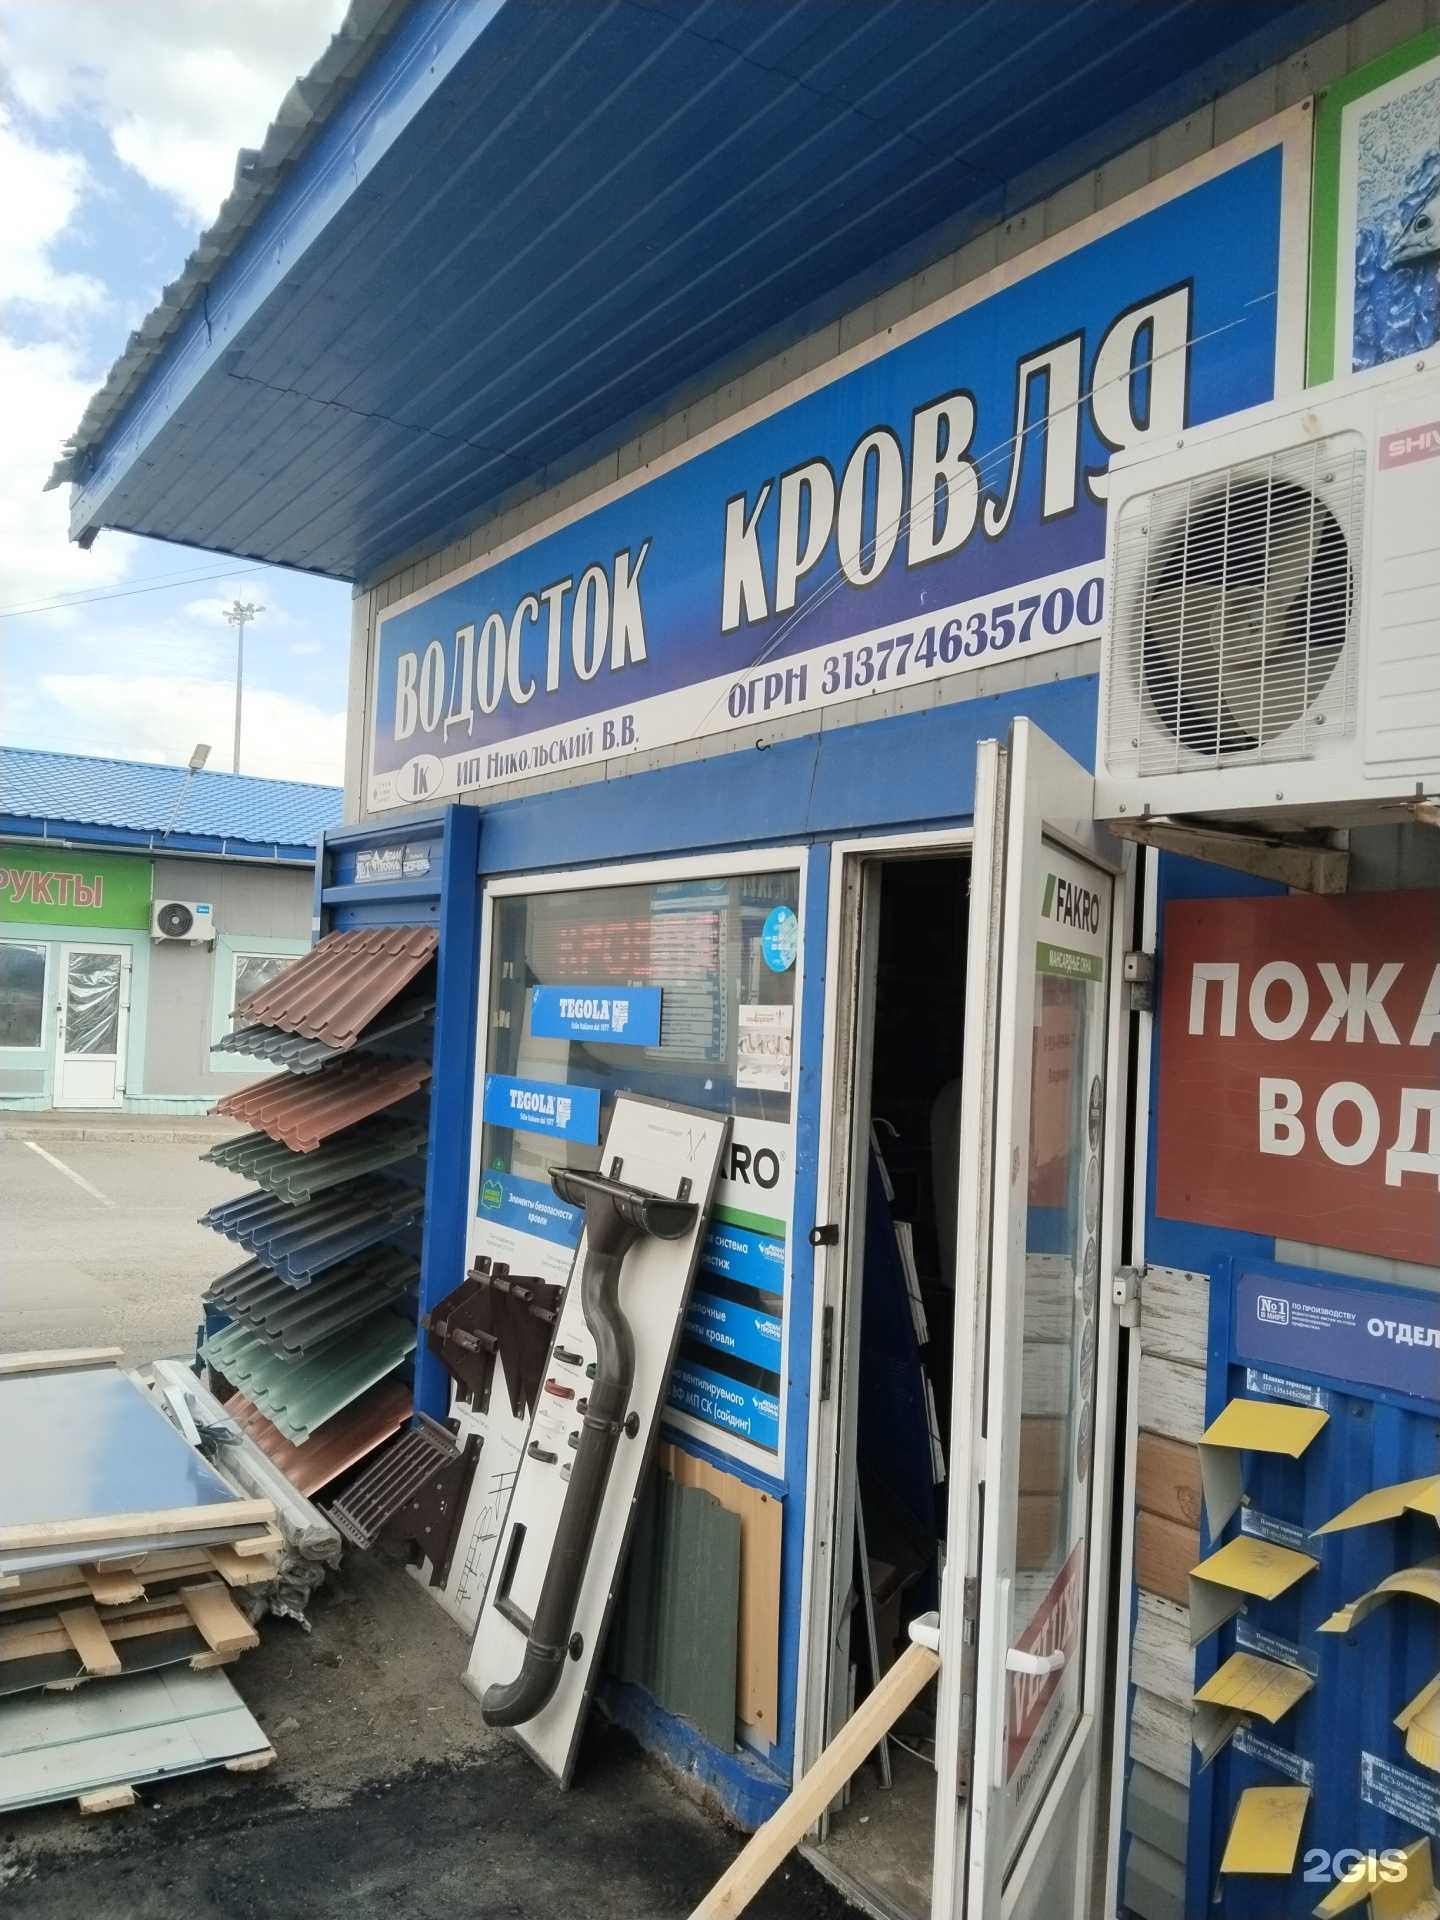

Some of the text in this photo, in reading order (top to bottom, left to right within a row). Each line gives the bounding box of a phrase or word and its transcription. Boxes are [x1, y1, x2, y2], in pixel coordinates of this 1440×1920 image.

[393, 275, 1196, 744] ВОДОСТОК КРОВЛЯ
[726, 664, 808, 718] ОГРН
[456, 757, 482, 787] ИП
[601, 714, 641, 750] В.В.
[1056, 877, 1100, 934] FAKRO
[559, 998, 610, 1021] TEGOLA
[509, 1088, 555, 1116] TEGOLA
[715, 1235, 748, 1254] система
[1292, 1302, 1357, 1321] ПО ПРОИЗВОДСТВУ
[705, 1328, 735, 1348] кровли
[682, 1371, 745, 1407] вентилируемого
[700, 1398, 713, 1415] СК
[713, 1402, 752, 1436] (сайдинг)
